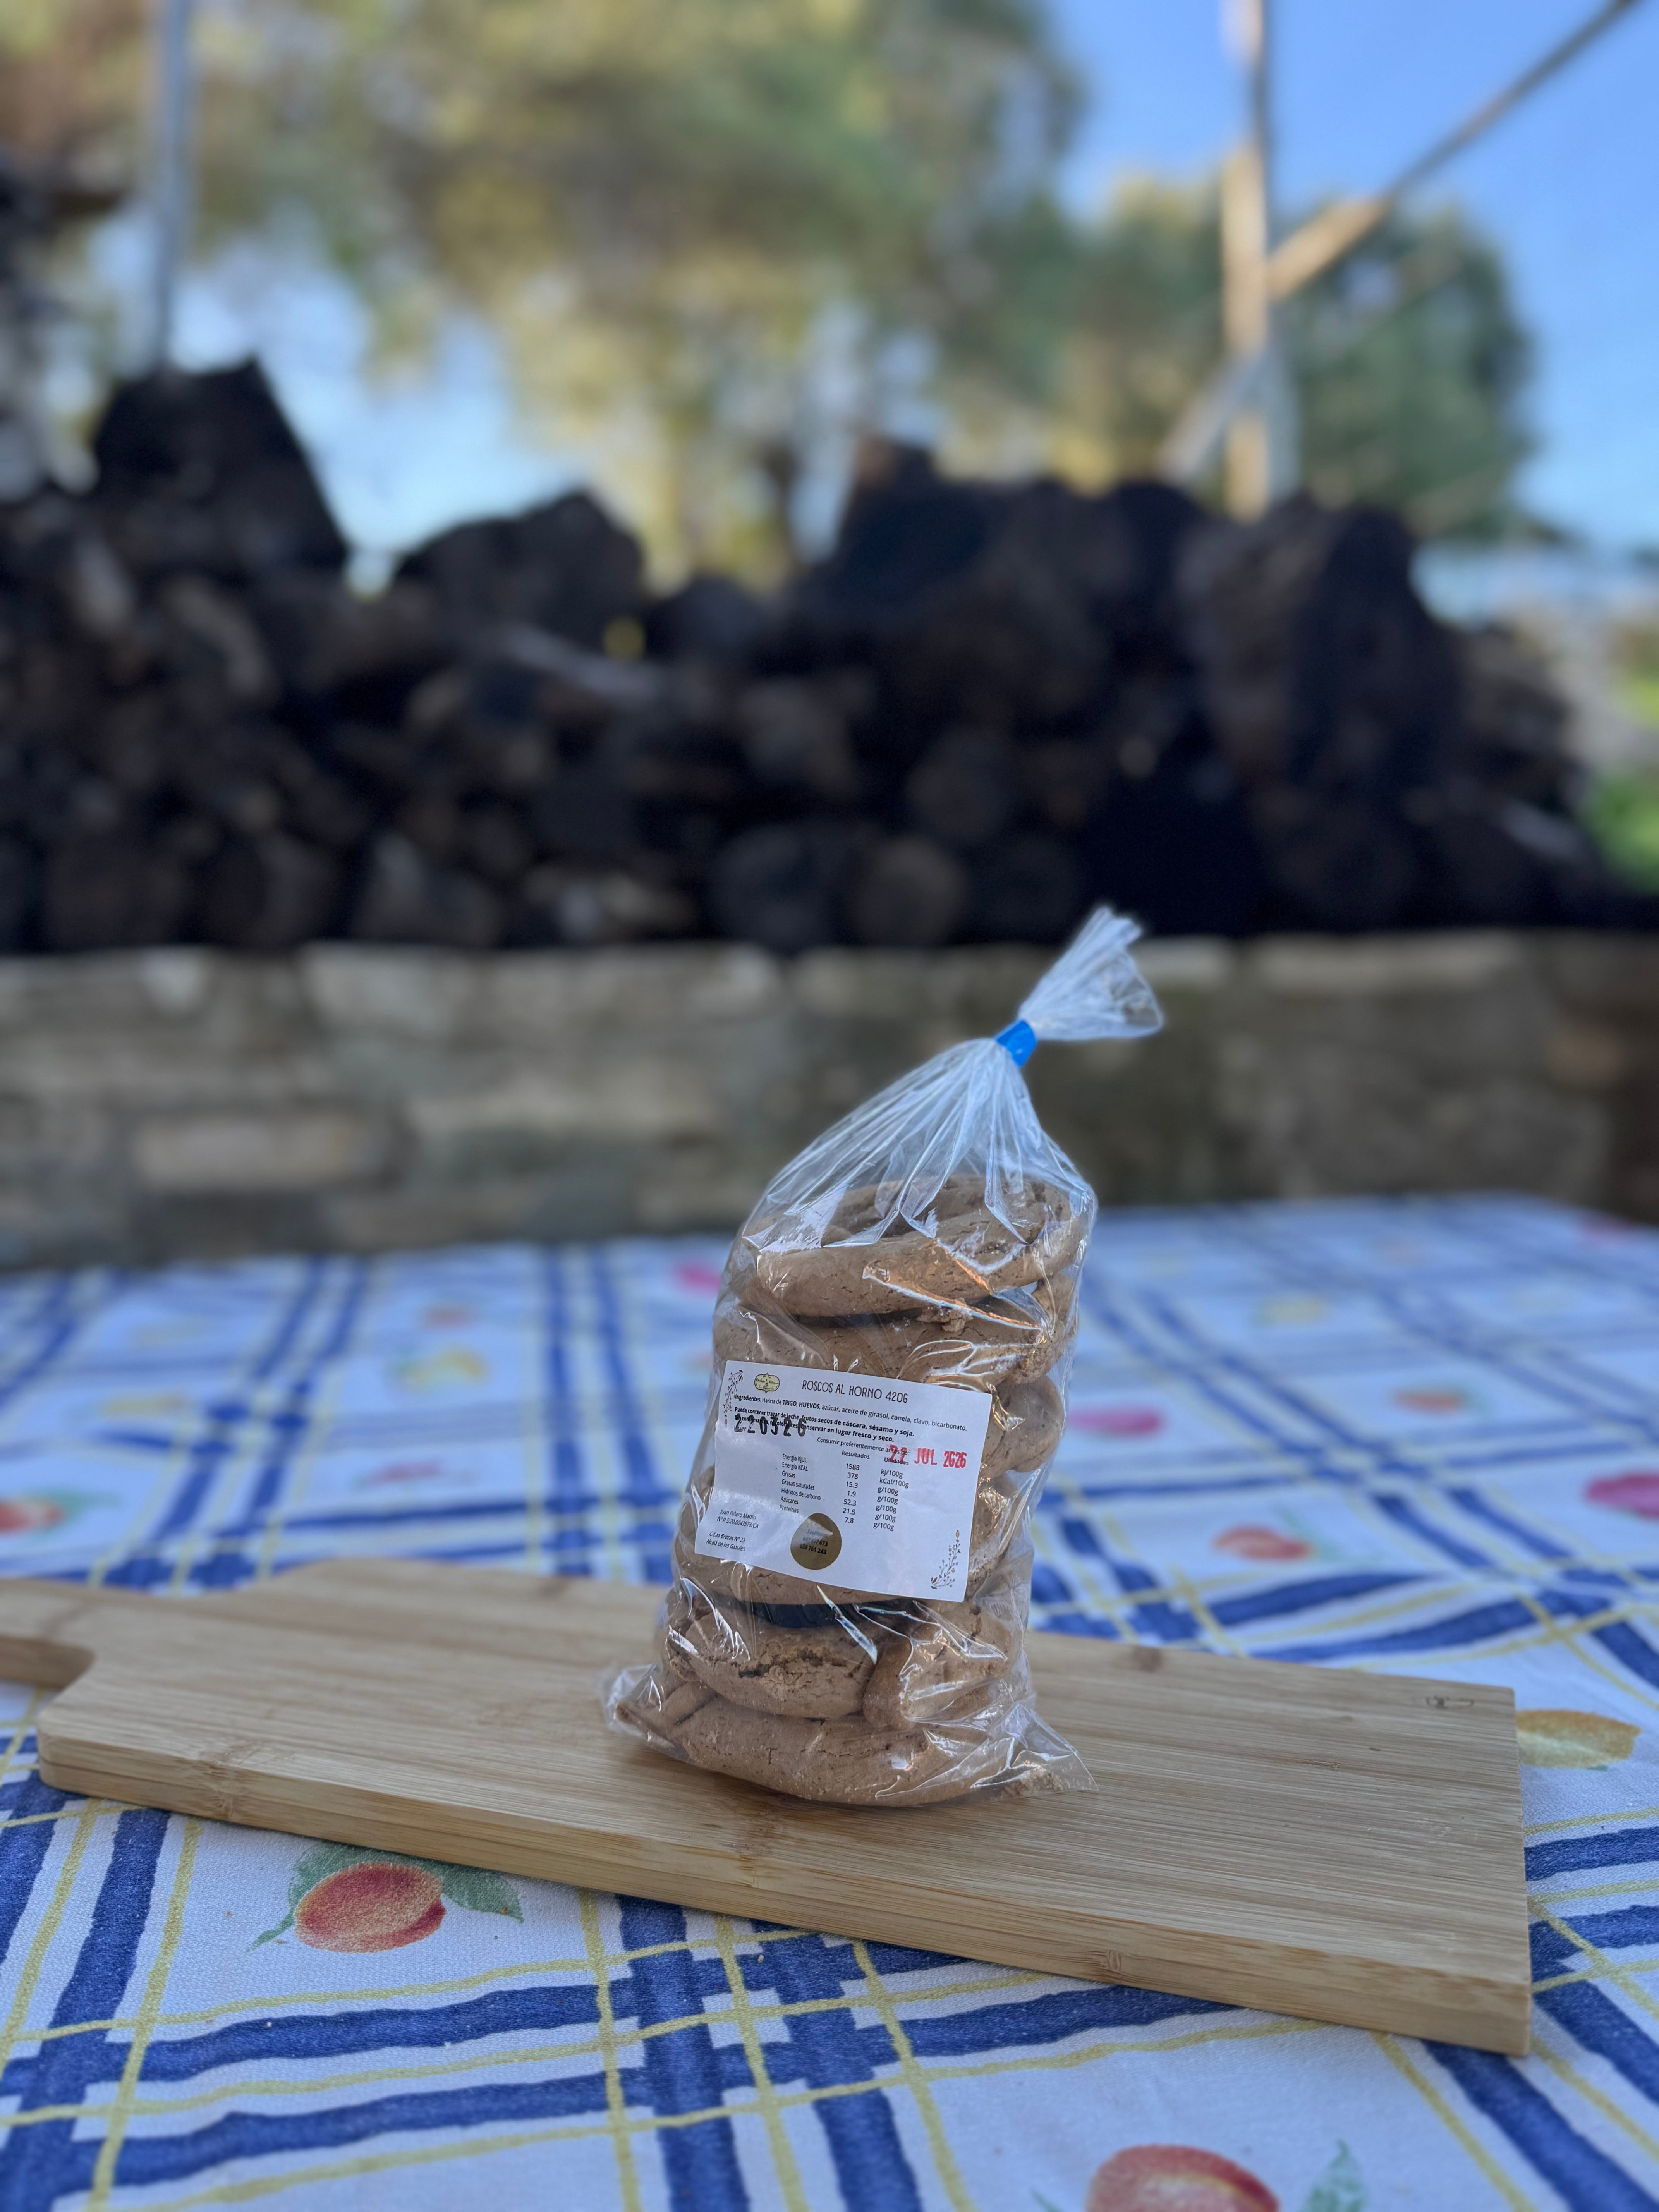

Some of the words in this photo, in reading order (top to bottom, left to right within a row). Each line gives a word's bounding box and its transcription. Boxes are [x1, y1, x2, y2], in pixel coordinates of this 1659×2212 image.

[802, 1380, 833, 1393] ROSCOS
[835, 1384, 845, 1394] AL
[849, 1386, 882, 1399] HORNO
[885, 1391, 908, 1403] 420G
[735, 1394, 761, 1402] Ingredientes:
[799, 1401, 820, 1410] HUEVOS,
[868, 1411, 890, 1420] girasol,
[891, 1415, 911, 1423] canela,
[914, 1418, 930, 1426] clavo,
[931, 1420, 967, 1431] bicarbonato.
[843, 1421, 867, 1429] cáscara,
[869, 1424, 893, 1433] sésamo
[836, 1428, 851, 1436] lugar
[840, 1441, 884, 1452] preferentemente
[842, 1450, 870, 1459] Resultados
[914, 1448, 937, 1465] JUL
[879, 1477, 909, 1489] kCal/100g
[781, 1488, 798, 1496] Hidratos
[877, 1487, 898, 1496] g/100g
[877, 1496, 898, 1505] g/100g
[875, 1505, 896, 1514] g/100g
[875, 1514, 896, 1523] g/100g
[873, 1523, 894, 1532] g/100g
